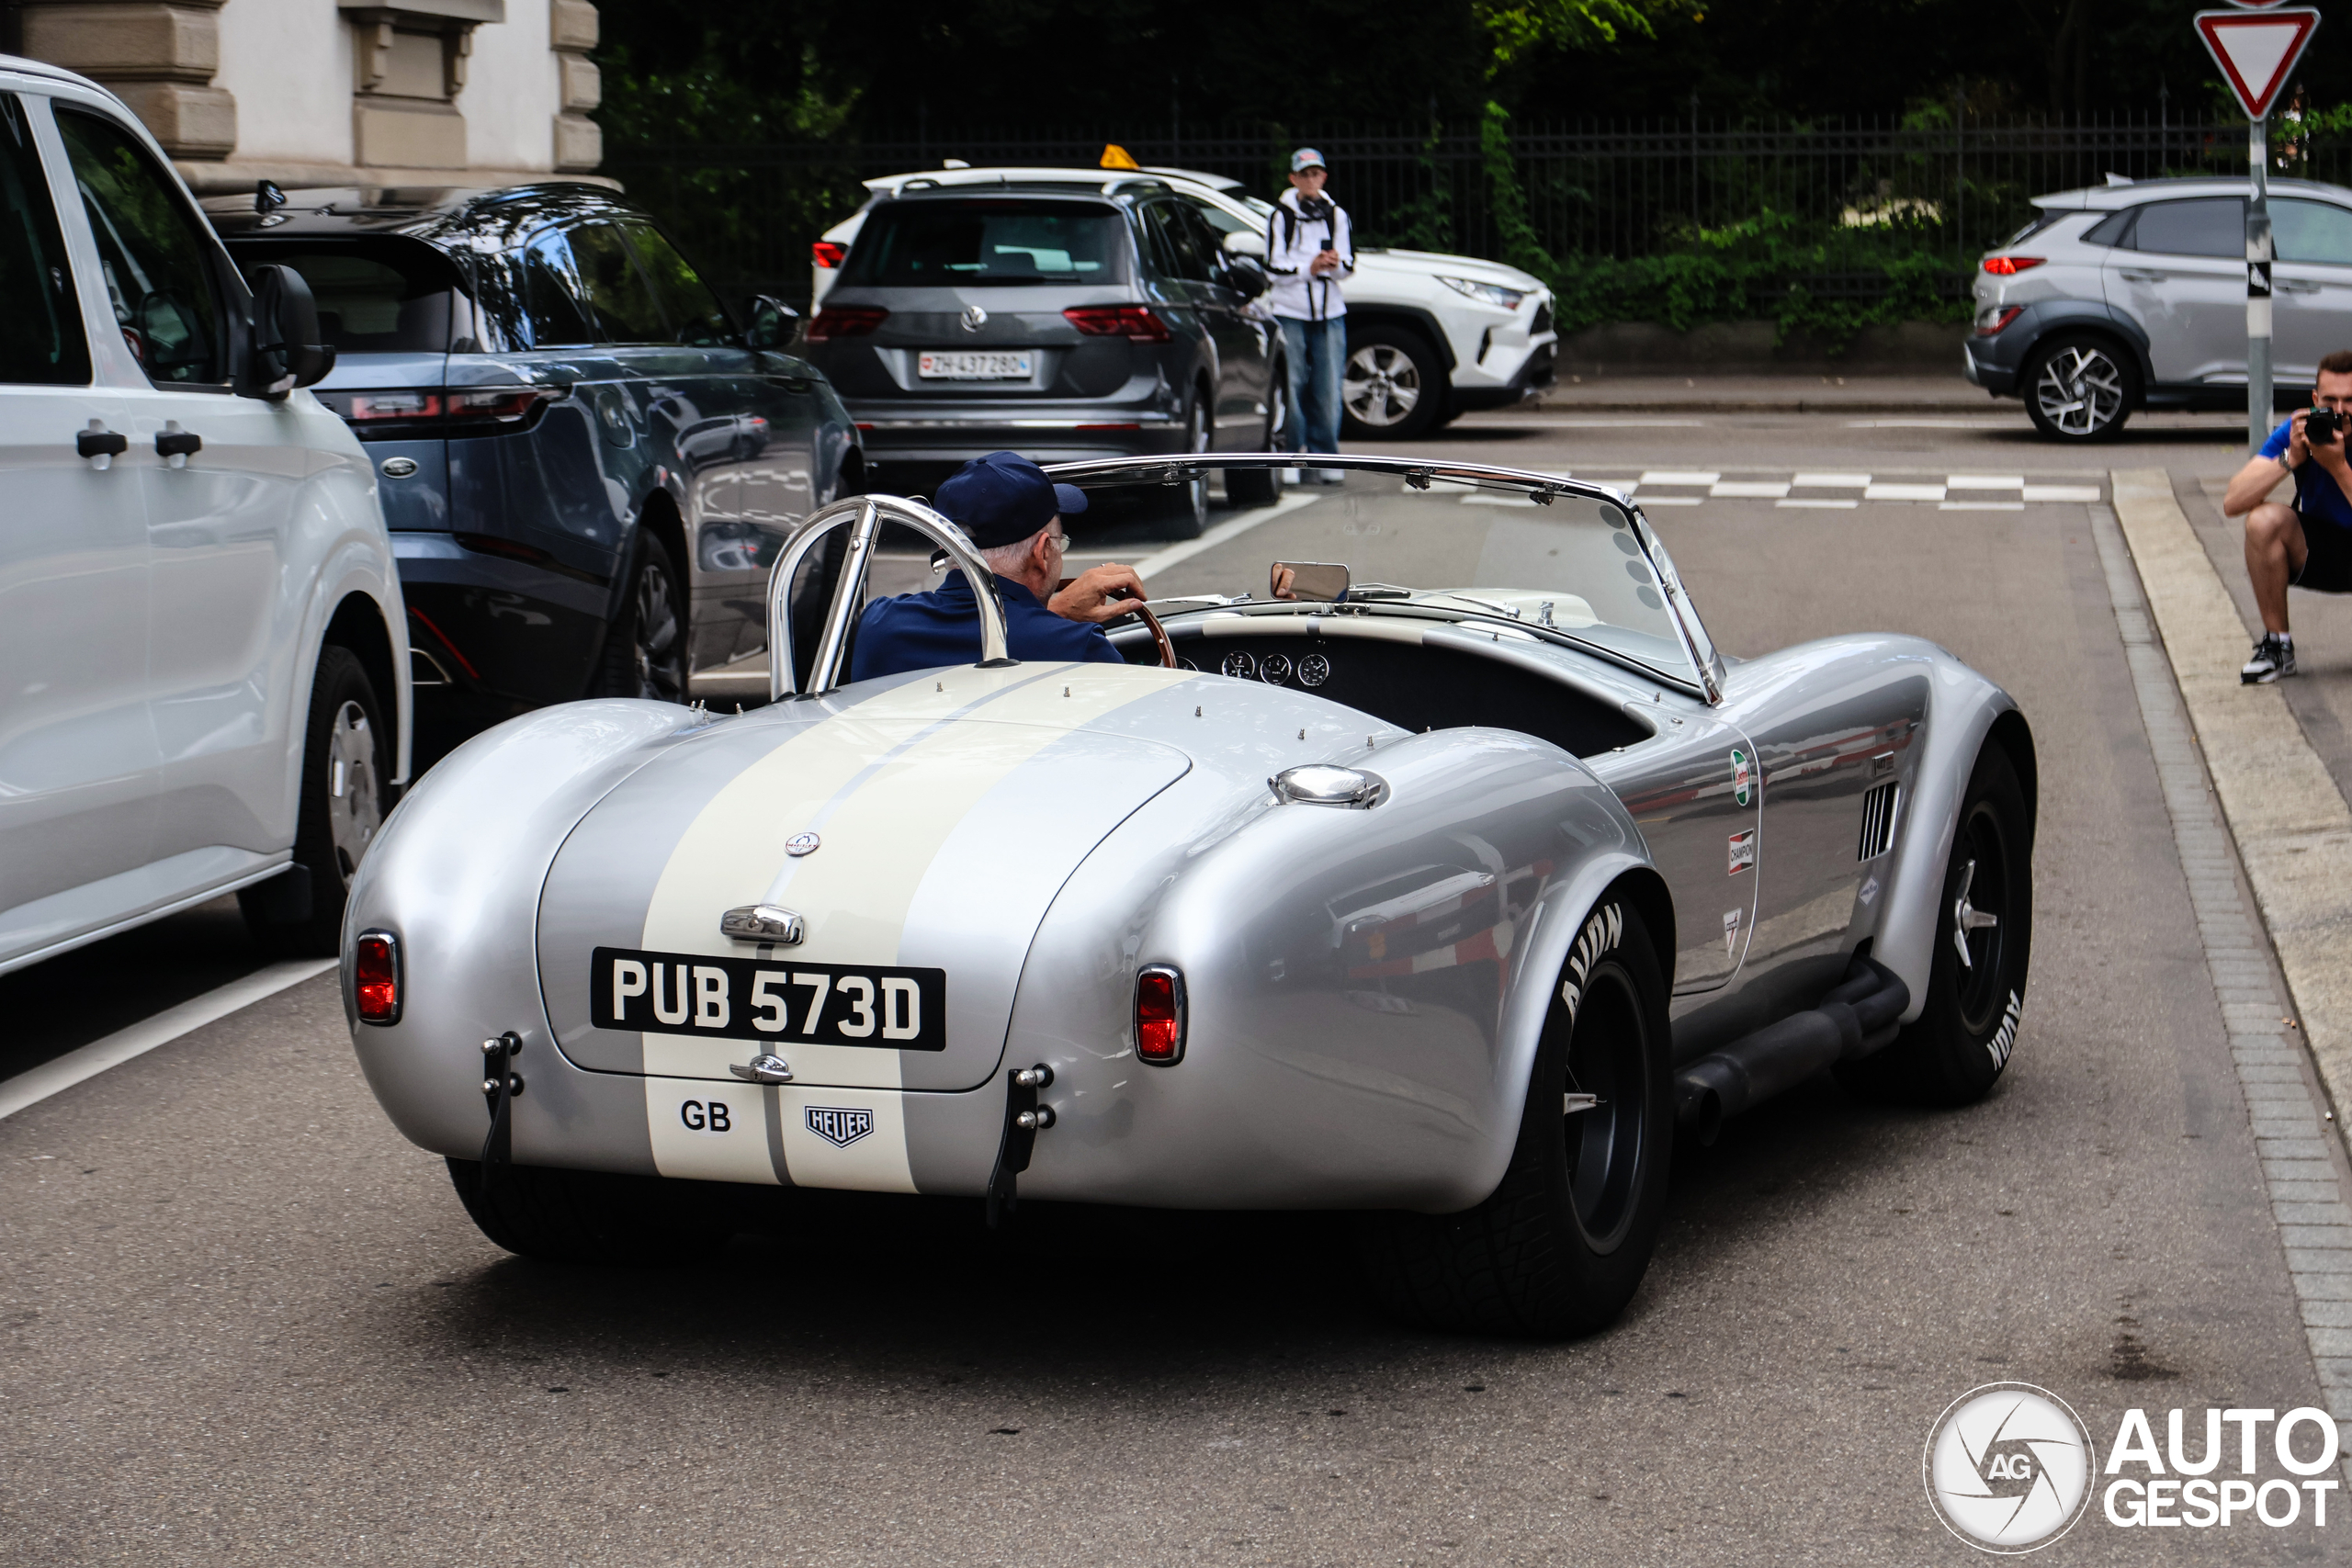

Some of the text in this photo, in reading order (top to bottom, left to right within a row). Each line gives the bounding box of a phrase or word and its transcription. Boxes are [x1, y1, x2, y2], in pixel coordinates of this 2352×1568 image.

[1731, 843, 1753, 862] CHAMPION
[1562, 902, 1623, 1032] AVON
[614, 959, 920, 1040] PUB 573D
[1986, 988, 2021, 1071] AVON
[681, 1100, 731, 1133] GB
[812, 1111, 868, 1142] HEUER
